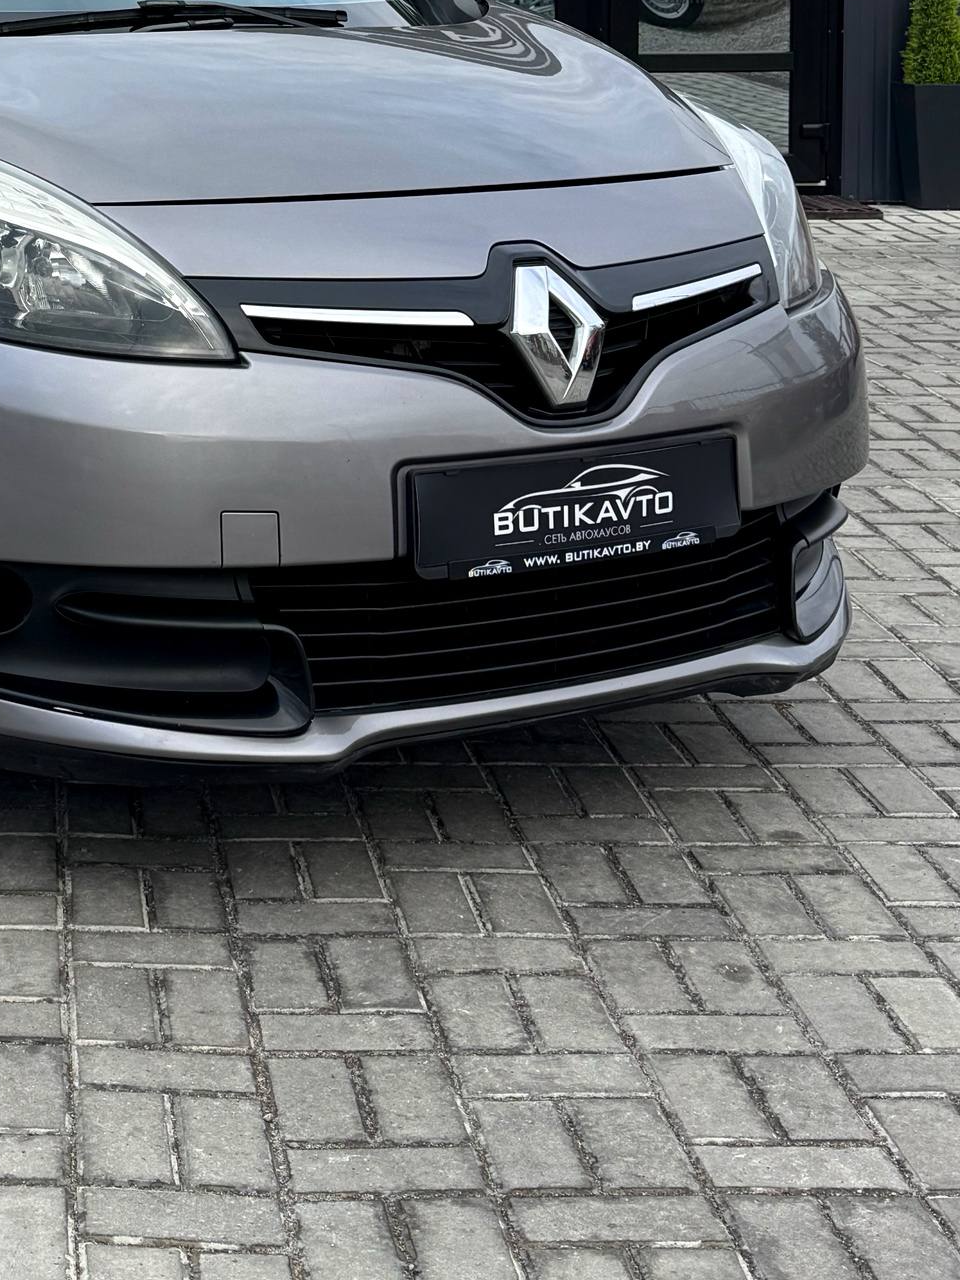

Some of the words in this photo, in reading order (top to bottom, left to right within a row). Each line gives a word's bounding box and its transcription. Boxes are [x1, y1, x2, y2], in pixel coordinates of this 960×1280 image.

[494, 490, 674, 537] BUTIKAVTO
[544, 532, 567, 545] СЕТЬ
[568, 524, 631, 542] АВТОХАУСОВ
[662, 537, 700, 550] BUTIKAVTO
[524, 554, 561, 568] WWW.
[565, 539, 652, 563] BUTIKAVTO.BY
[468, 565, 513, 578] BUTIKAVTO
